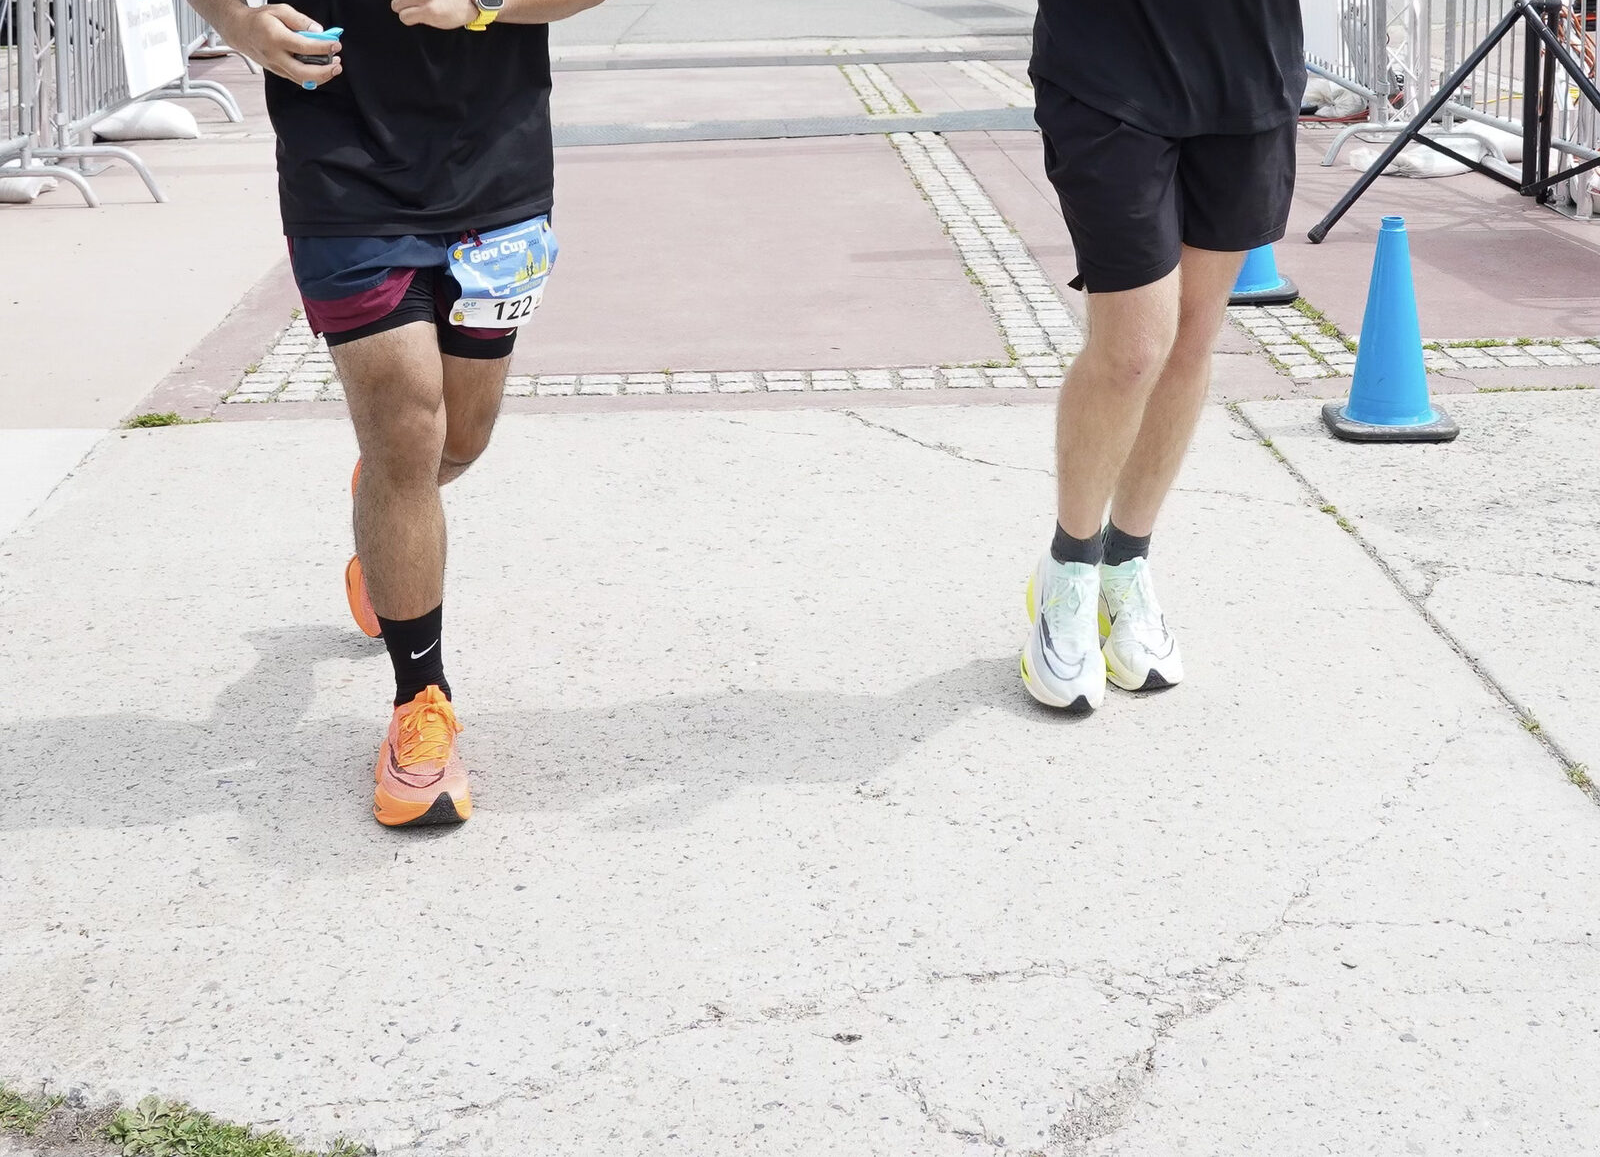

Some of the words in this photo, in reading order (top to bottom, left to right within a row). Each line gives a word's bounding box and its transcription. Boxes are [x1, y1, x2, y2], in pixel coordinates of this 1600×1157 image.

[469, 247, 498, 263] Gov
[500, 239, 527, 254] Cup
[494, 295, 533, 321] 122
